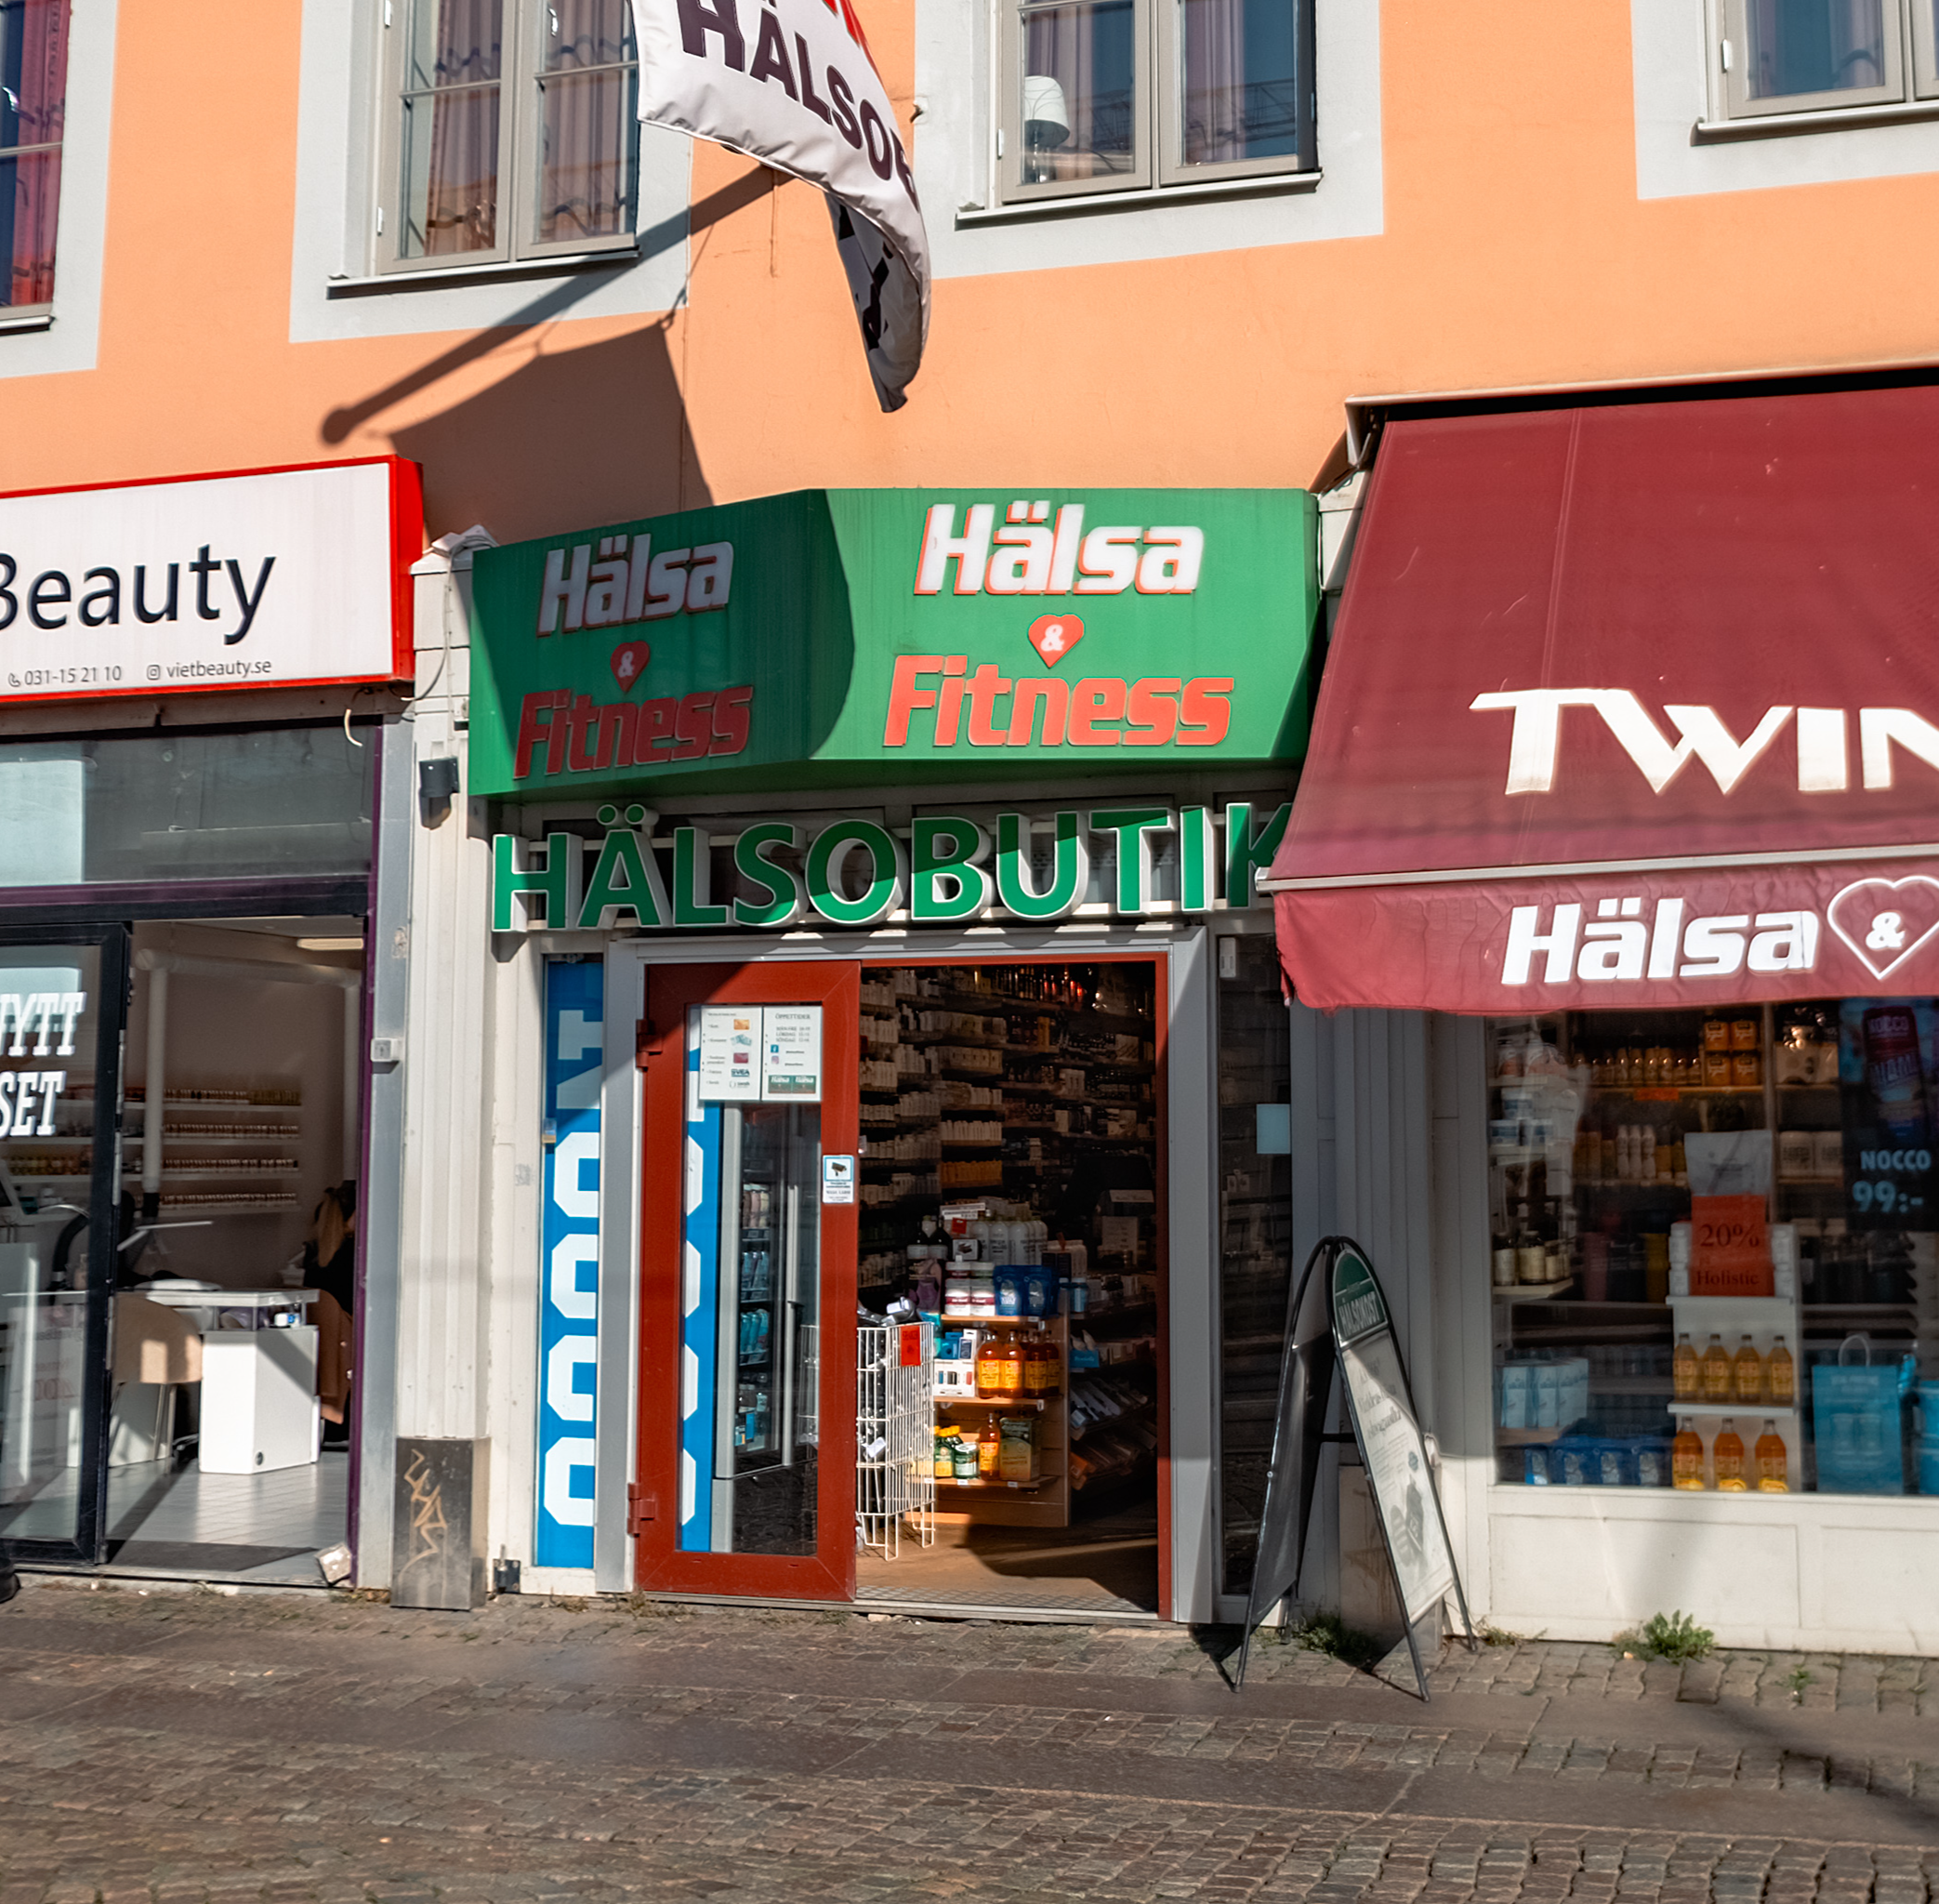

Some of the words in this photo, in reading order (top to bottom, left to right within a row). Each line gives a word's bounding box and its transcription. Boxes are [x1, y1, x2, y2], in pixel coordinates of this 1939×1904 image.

[913, 500, 1205, 596] Hälsa
[536, 533, 734, 639] Hälsa
[1040, 624, 1065, 652] &
[24, 668, 76, 686] 031-15
[80, 668, 98, 683] 21
[104, 665, 123, 681] 10
[166, 659, 272, 680] vietbeauty.se
[617, 651, 634, 678] &
[883, 654, 1234, 747] Fitness
[513, 684, 754, 779] Fitness
[1500, 896, 1820, 985] Hälsa
[1865, 911, 1906, 951] &
[1860, 1149, 1932, 1170] NOCCO
[1853, 1180, 1924, 1213] 99:-
[1699, 1223, 1760, 1248] 20%
[1696, 1269, 1760, 1287] Holistic
